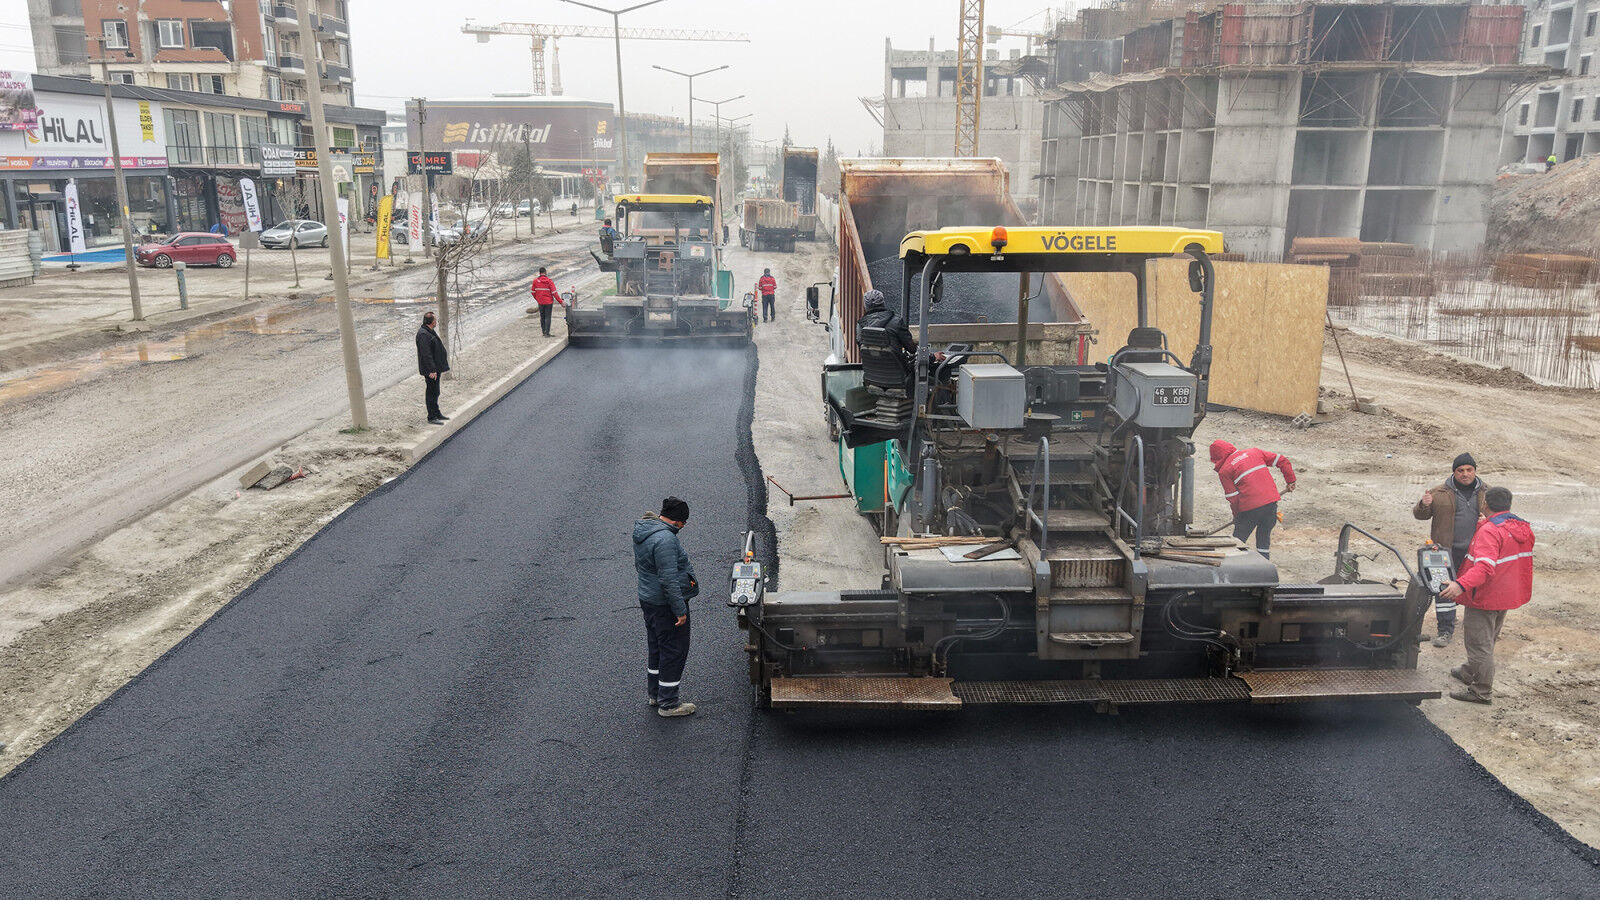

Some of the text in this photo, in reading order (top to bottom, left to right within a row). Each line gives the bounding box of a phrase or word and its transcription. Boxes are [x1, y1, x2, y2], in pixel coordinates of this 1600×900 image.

[470, 122, 552, 143] istikbal
[262, 146, 280, 159] ODAK
[1041, 232, 1117, 250] VÖGELE
